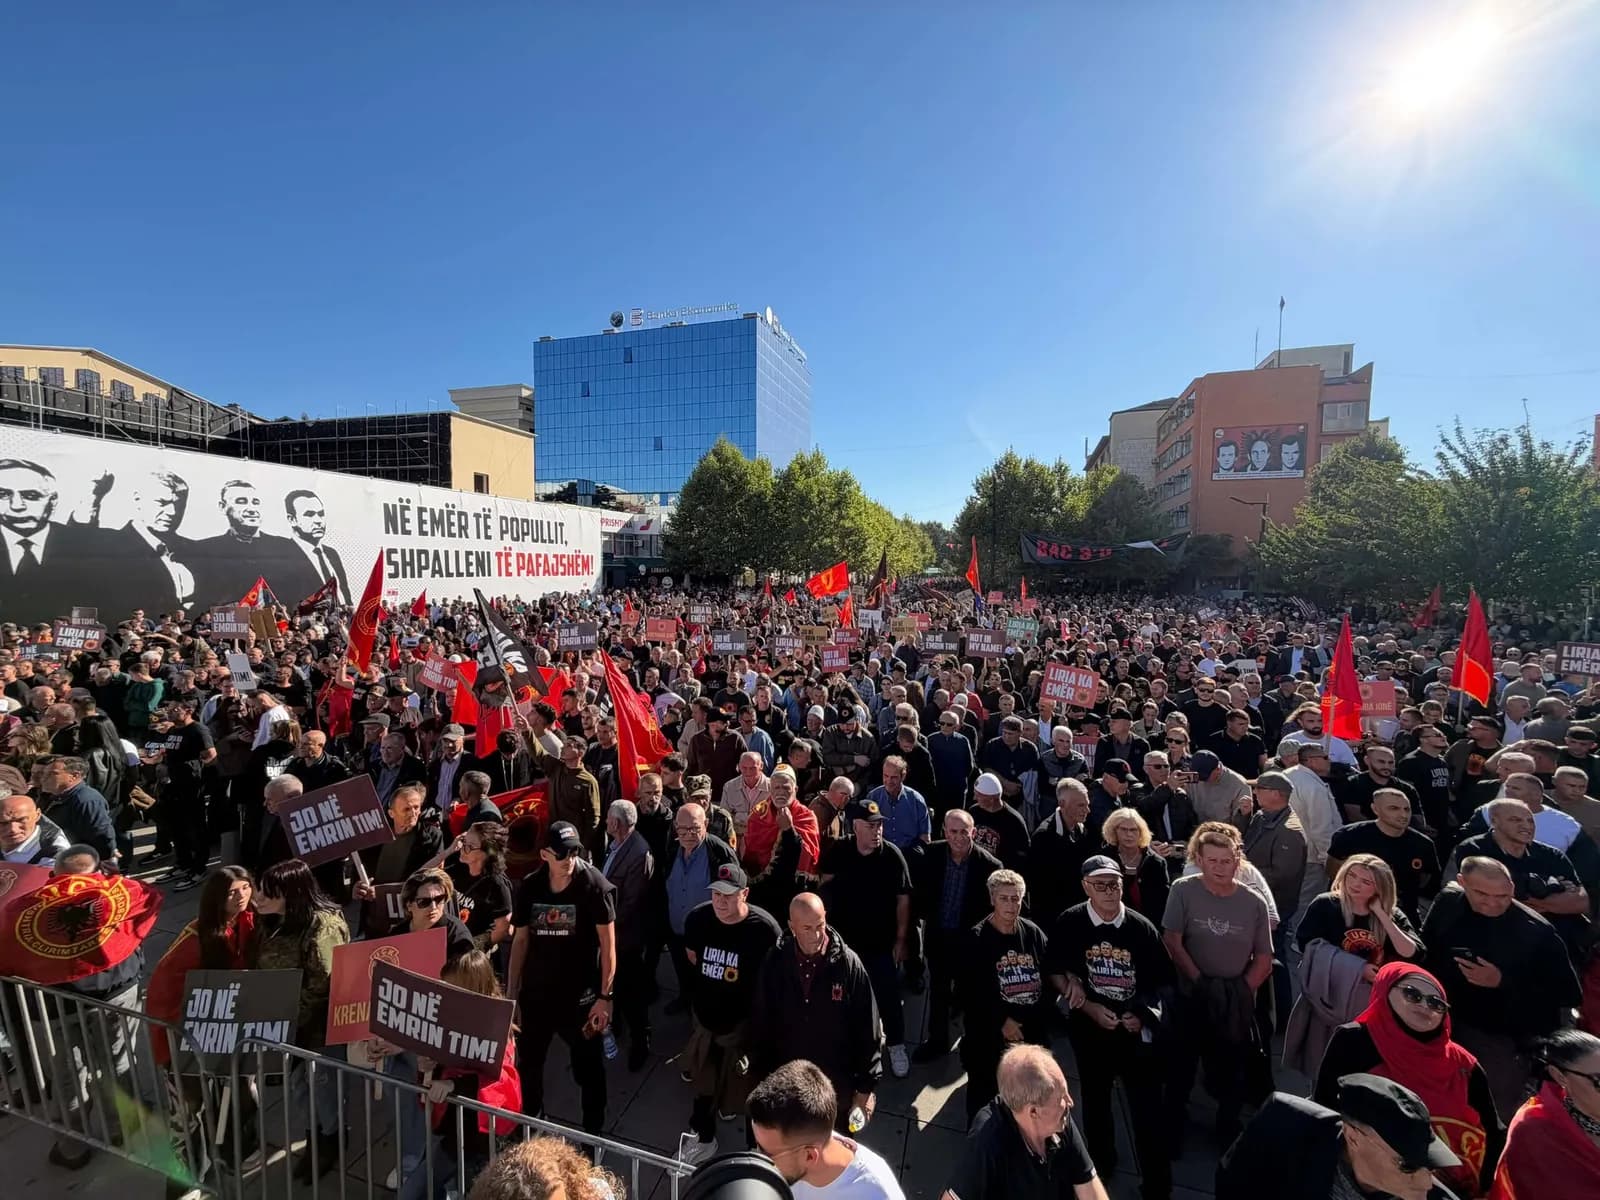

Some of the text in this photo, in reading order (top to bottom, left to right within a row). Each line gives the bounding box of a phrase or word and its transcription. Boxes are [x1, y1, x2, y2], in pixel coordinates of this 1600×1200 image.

[383, 497, 568, 546] NË EMËR TË POPULLIT,
[386, 546, 594, 579] SHPALLENI TË PAFAJSHËM!
[56, 636, 84, 648] EMËR
[59, 627, 100, 640] LIRIA KA
[1561, 659, 1600, 674] EMËR
[1562, 646, 1600, 660] LIRIA
[1045, 682, 1075, 700] EMËR
[1049, 667, 1093, 689] LIRIA KA
[289, 793, 343, 833] JO NË
[295, 808, 384, 856] EMRIN TIM!
[703, 946, 739, 968] LIRIA KA
[702, 962, 725, 980] EMËR
[186, 983, 240, 1020] JO NË
[378, 977, 442, 1023] JO NË
[180, 1020, 239, 1054] EMRIN
[376, 999, 499, 1064] EMRIN TIM!
